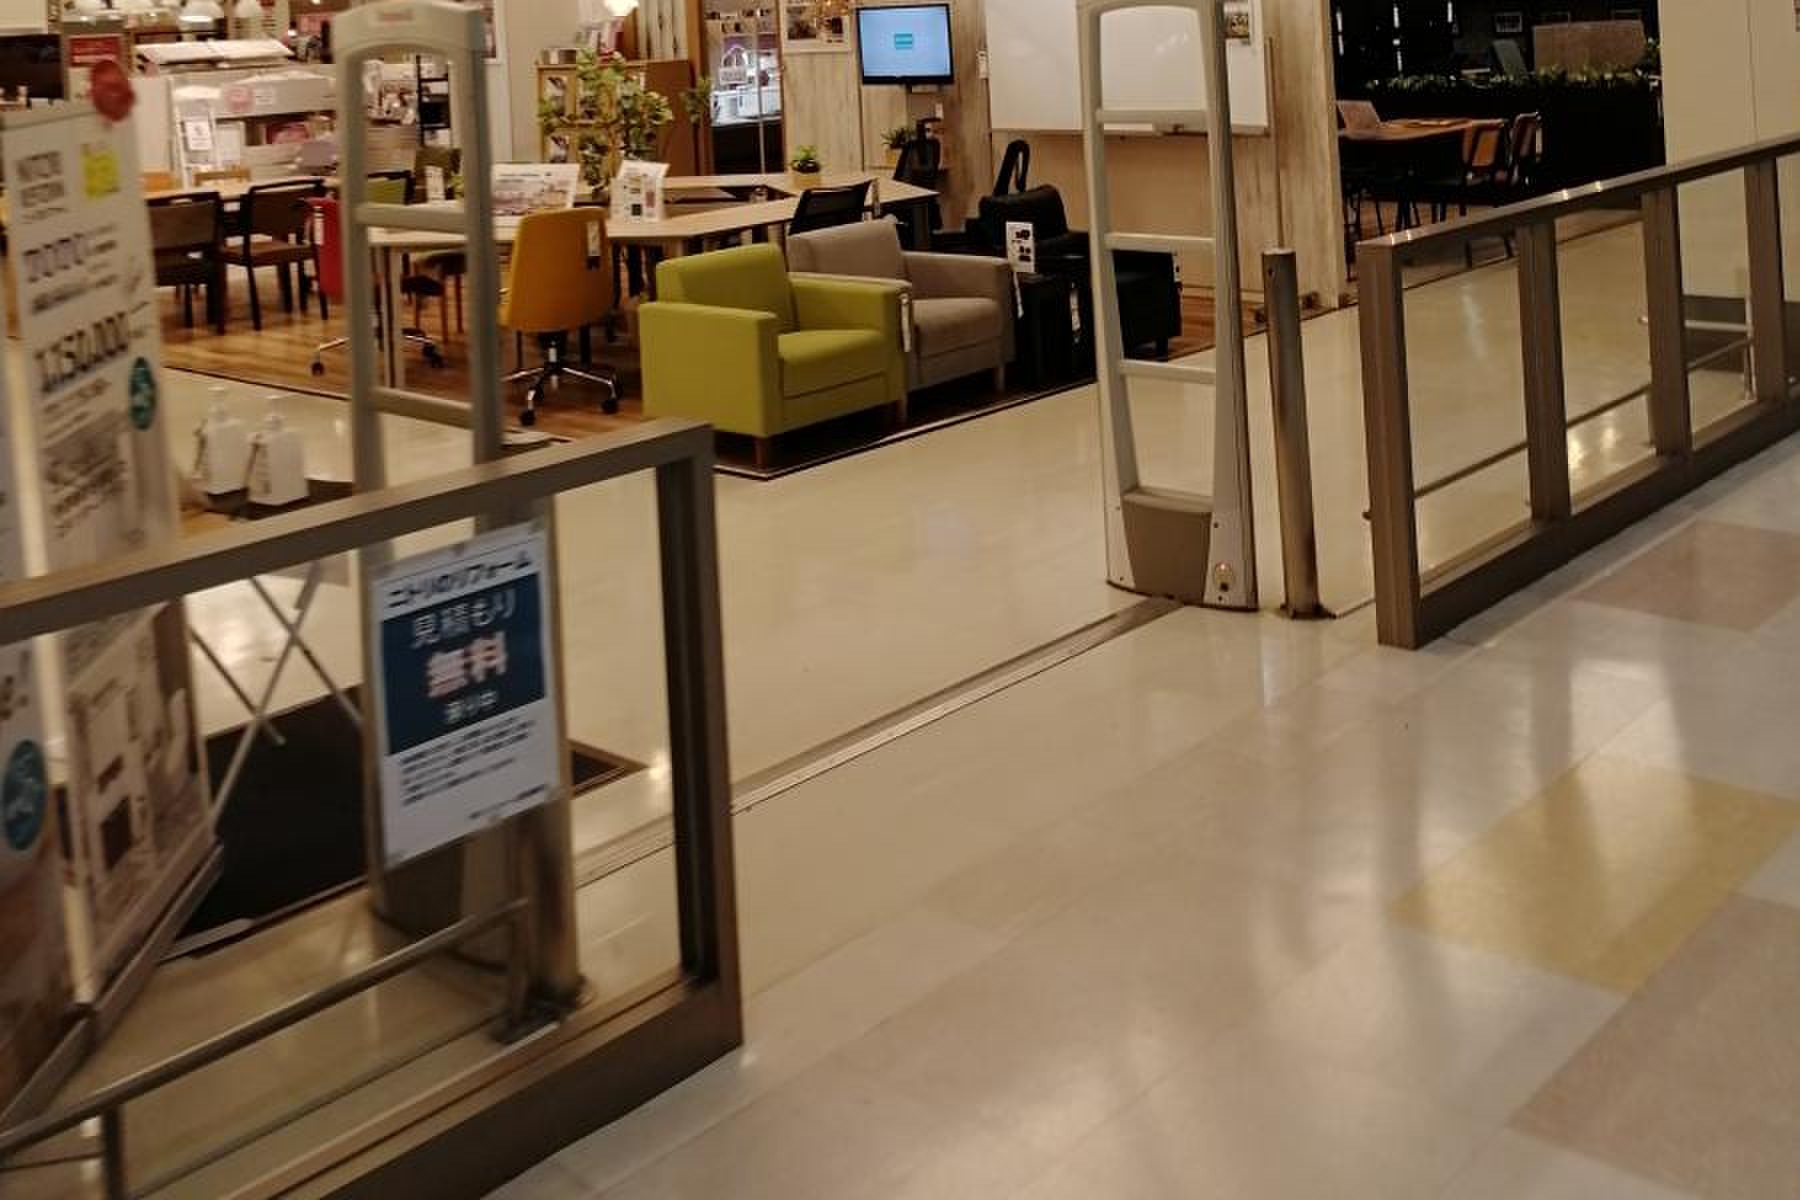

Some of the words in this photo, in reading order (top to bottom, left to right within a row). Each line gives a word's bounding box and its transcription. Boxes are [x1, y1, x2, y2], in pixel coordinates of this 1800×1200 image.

[389, 552, 531, 608] ニトリのリフォーム
[427, 632, 508, 697] 無料
